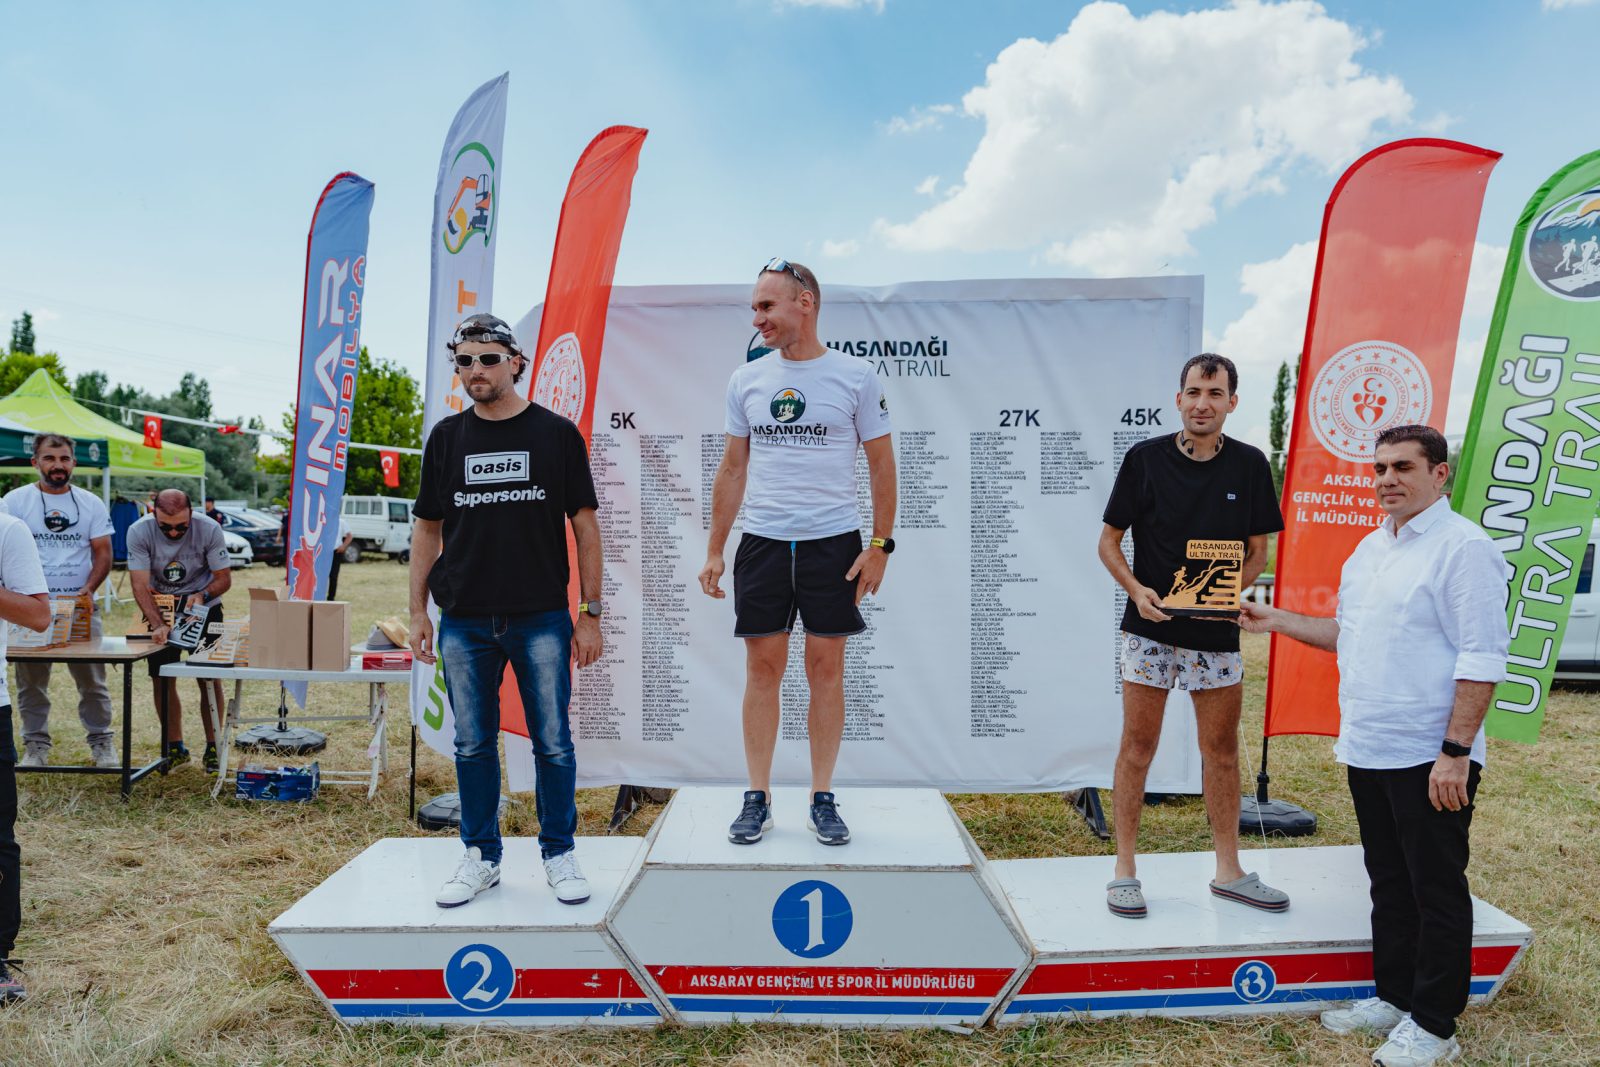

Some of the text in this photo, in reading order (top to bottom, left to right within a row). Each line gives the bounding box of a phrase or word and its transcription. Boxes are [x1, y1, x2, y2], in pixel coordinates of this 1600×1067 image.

[894, 360, 950, 376] TRAIL
[610, 412, 636, 430] 5K
[1000, 409, 1040, 427] 27K
[1120, 408, 1162, 426] 45K
[472, 458, 522, 475] oasis
[454, 486, 546, 508] Supersonic
[1292, 491, 1375, 508] GENÇLİK ve
[1296, 508, 1308, 522] İL
[1190, 542, 1242, 550] HASANDAĞI
[1495, 526, 1582, 714] ULTRA
[800, 888, 826, 952] 1
[460, 951, 500, 1002] 2
[690, 975, 754, 988] AKSARAY
[818, 976, 834, 988] VE
[837, 976, 872, 988] SPOR
[876, 974, 888, 988] İL
[892, 974, 975, 989] MÜDÜRLÜĞÜ
[1240, 966, 1266, 998] 3
